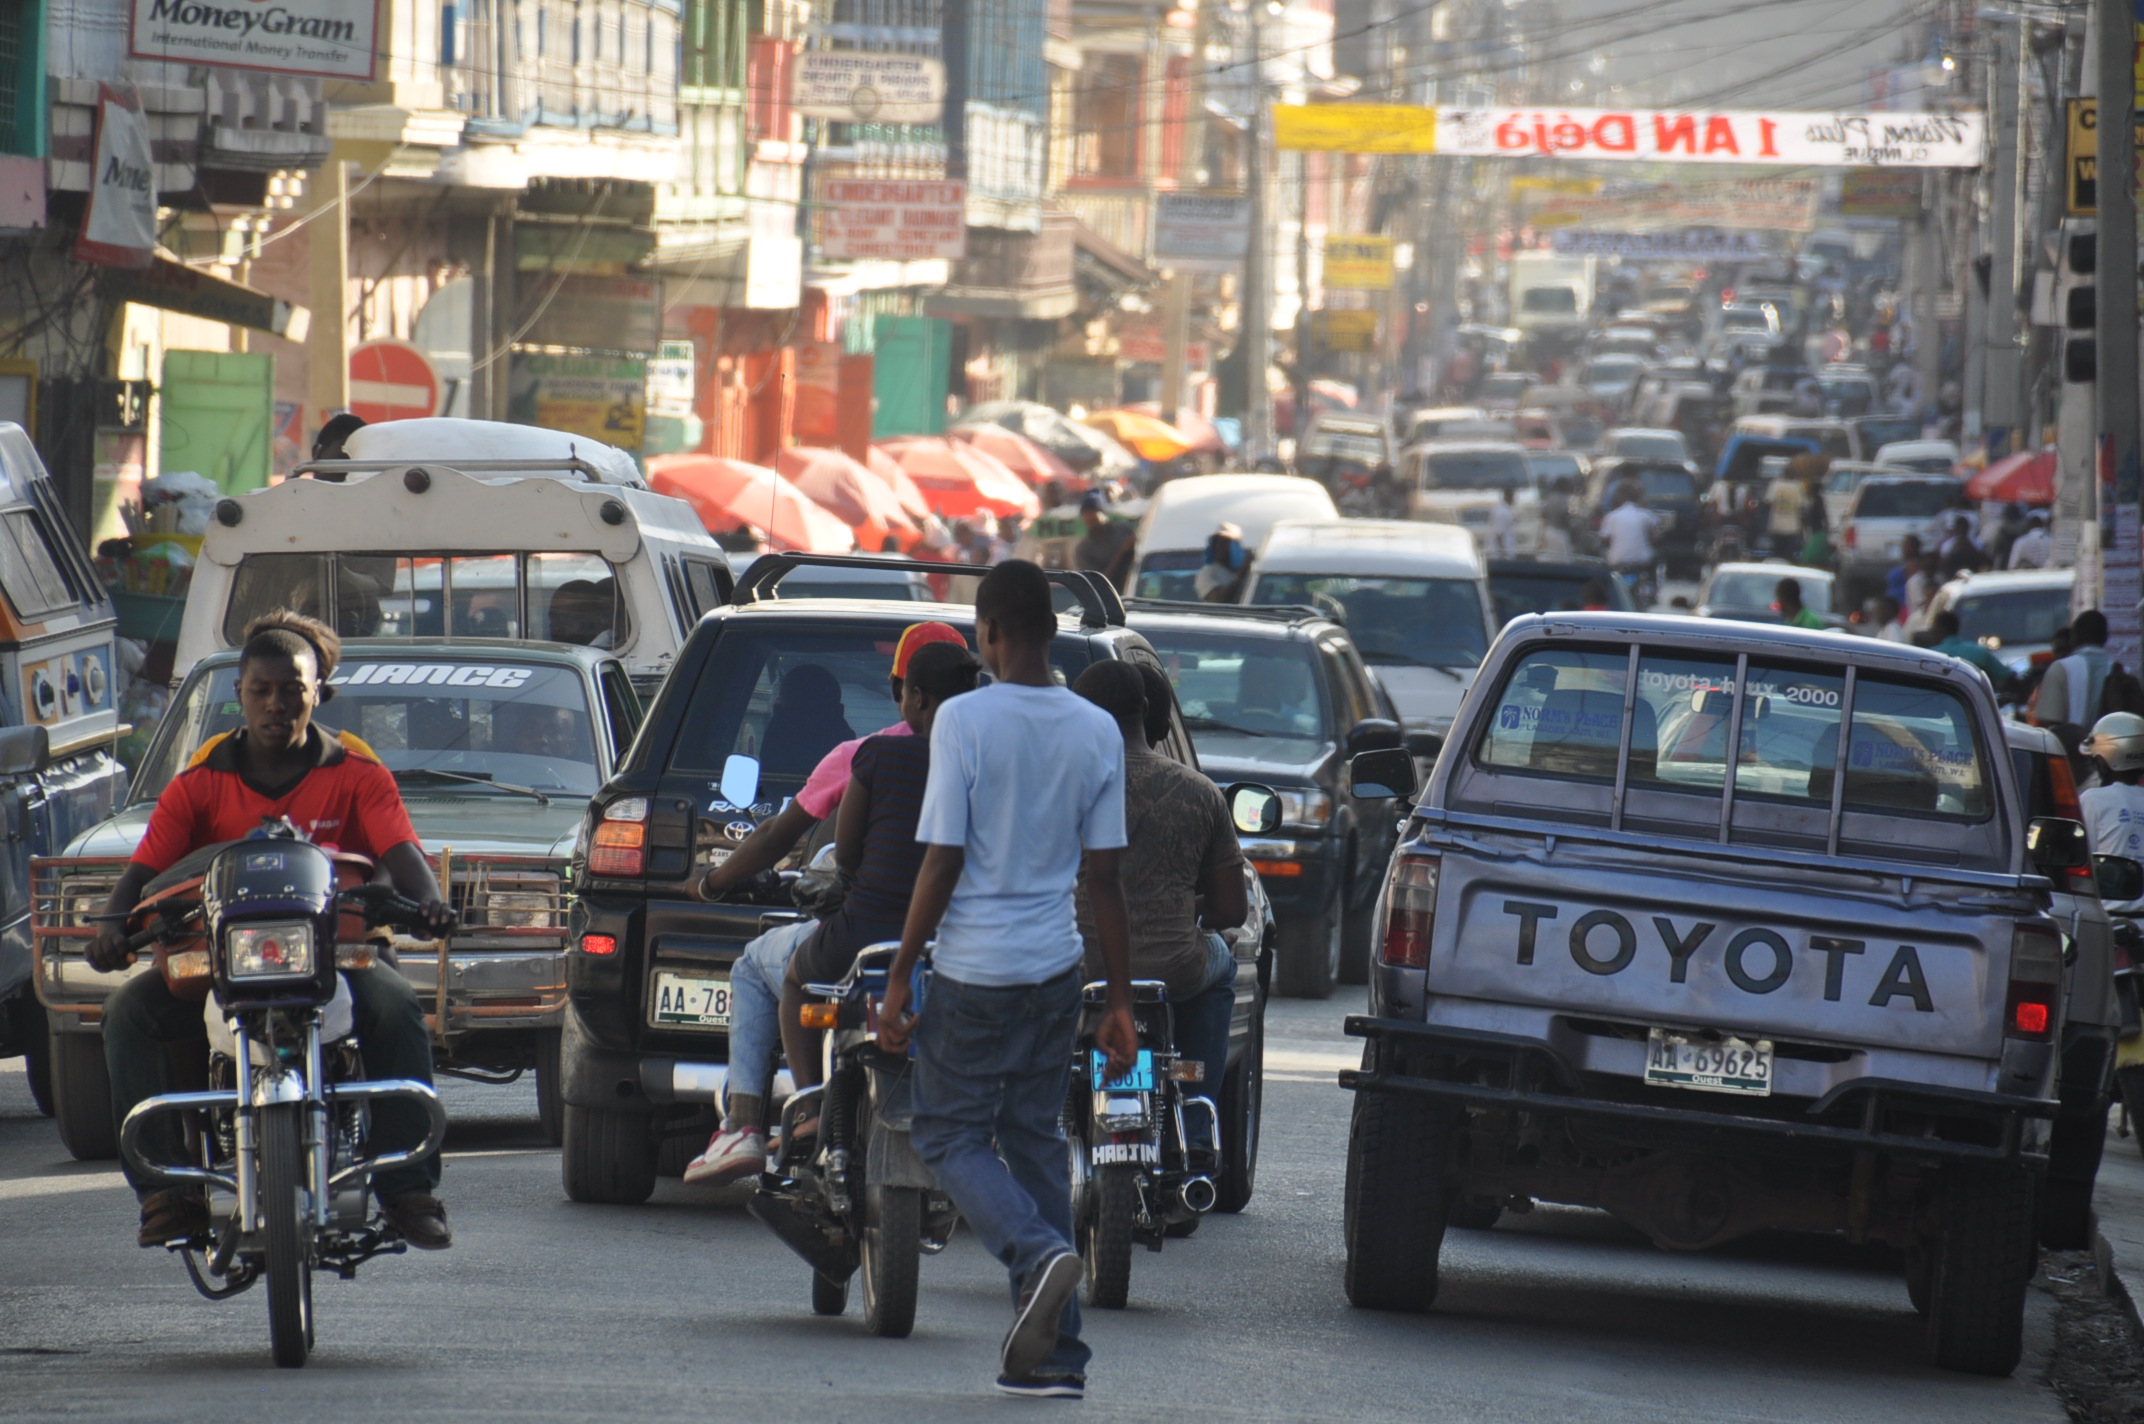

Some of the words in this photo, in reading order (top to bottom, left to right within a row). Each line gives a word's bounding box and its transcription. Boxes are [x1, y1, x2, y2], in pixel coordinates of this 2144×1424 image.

[149, 0, 355, 41] MoneyGram
[152, 31, 242, 51] International
[245, 42, 292, 60] Money
[296, 46, 349, 63] Transfer
[325, 664, 533, 688] LIANCE
[1643, 669, 1711, 692] toyota
[1721, 676, 1774, 697] hux
[1786, 687, 1838, 706] 2000
[708, 800, 773, 815] RA4
[1503, 900, 1935, 1012] TOYOTA
